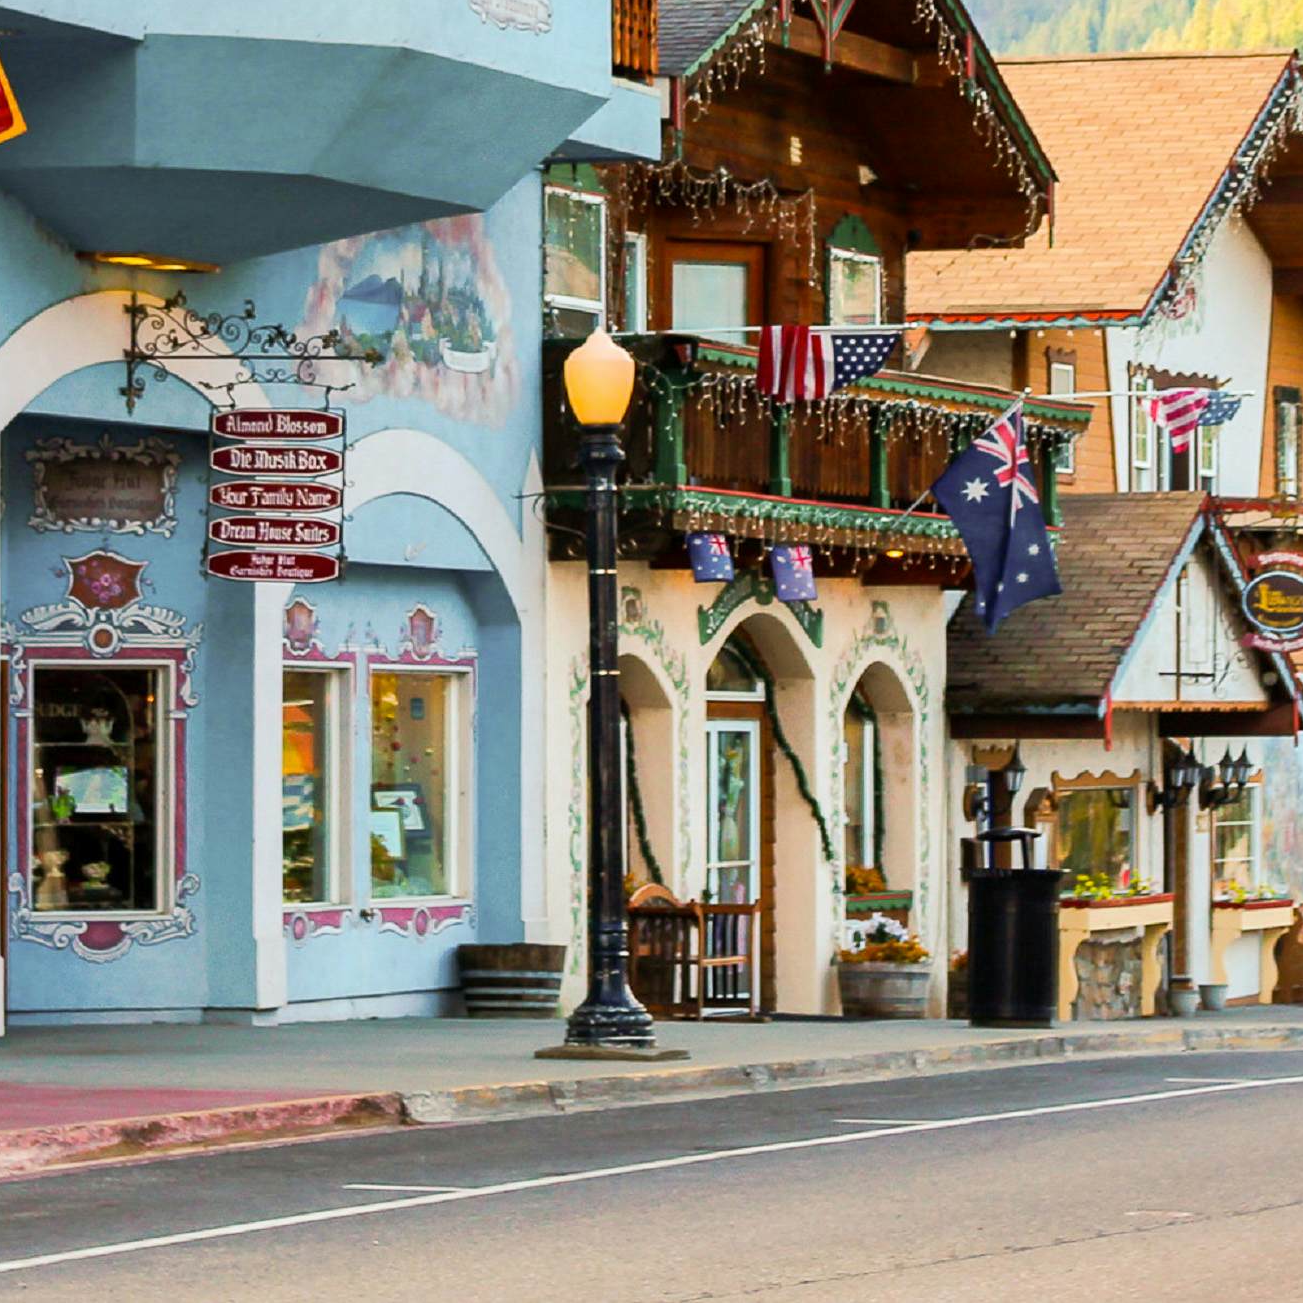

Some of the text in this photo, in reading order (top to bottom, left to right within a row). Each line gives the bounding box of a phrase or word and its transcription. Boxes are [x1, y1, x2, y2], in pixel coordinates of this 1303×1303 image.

[226, 414, 327, 434] Almond Blossom
[229, 448, 327, 470] Die Musik Box
[217, 486, 332, 507] Your Family Name
[220, 521, 256, 539] Dream
[257, 521, 293, 541] House
